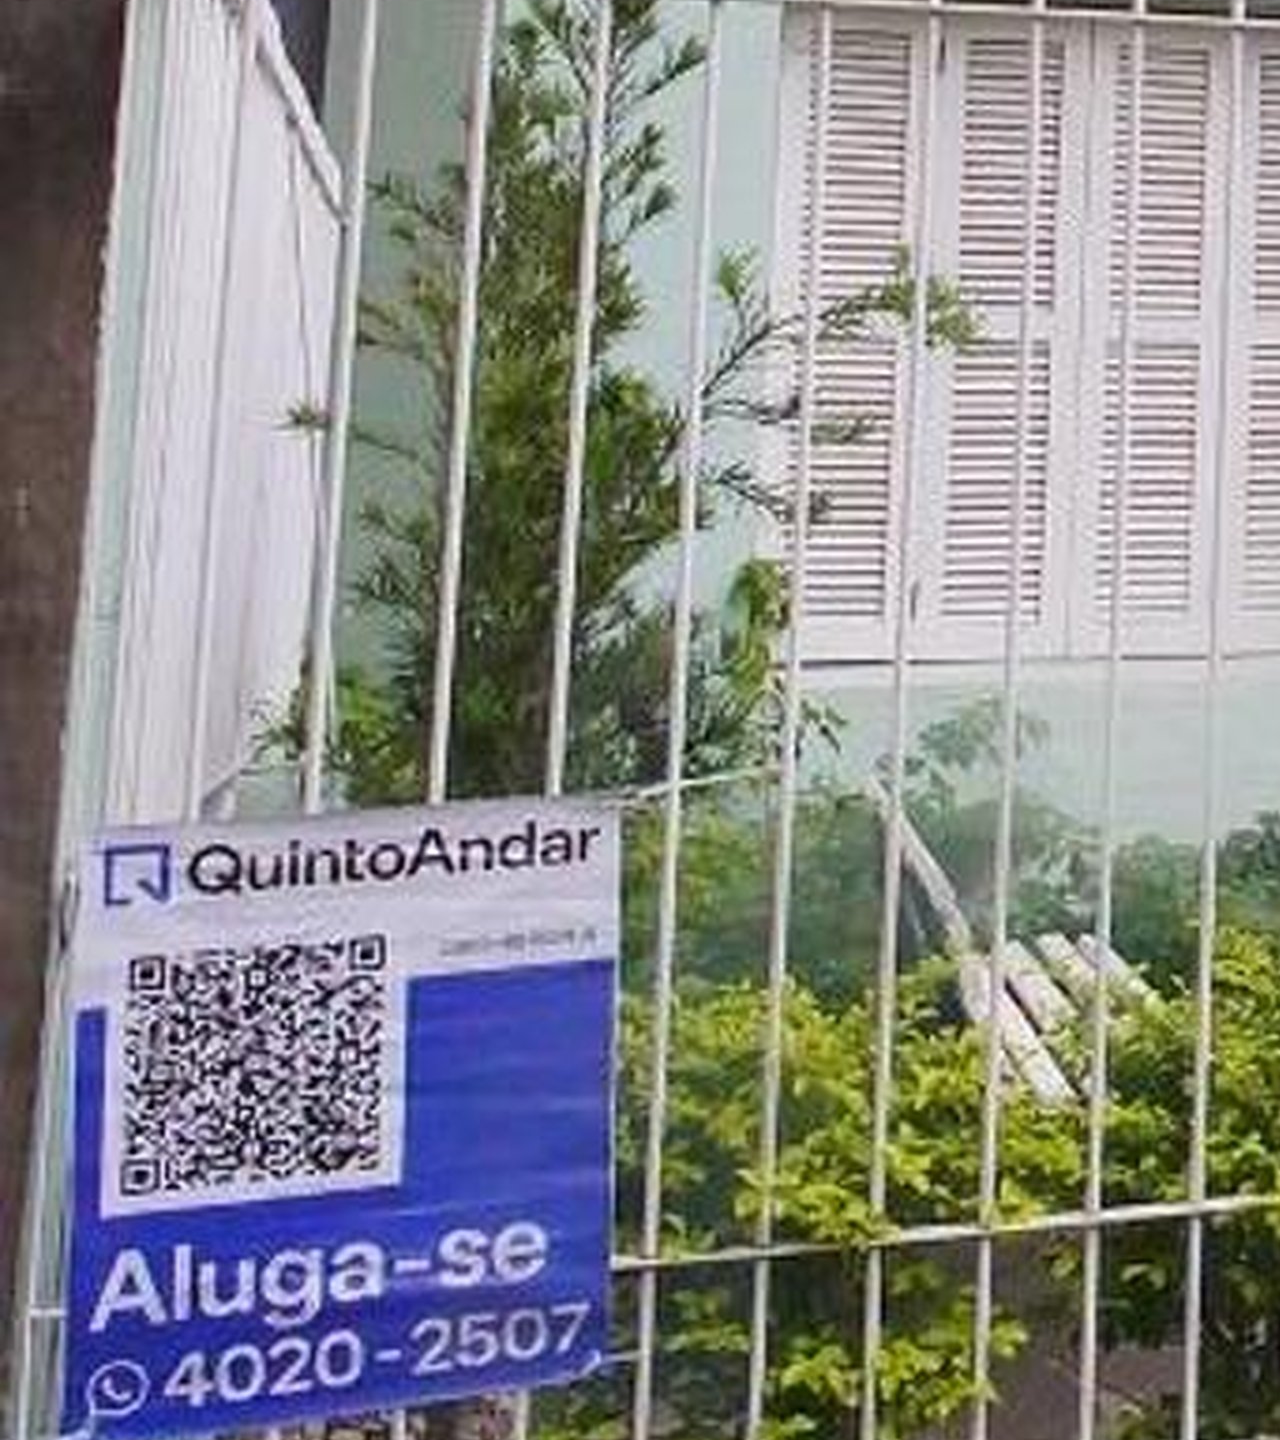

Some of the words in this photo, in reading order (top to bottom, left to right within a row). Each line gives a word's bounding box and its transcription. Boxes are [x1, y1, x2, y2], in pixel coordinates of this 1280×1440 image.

[188, 821, 600, 895] QuintoAndar
[89, 1221, 549, 1330] Aluga-se
[163, 1301, 592, 1409] 4020-2507
